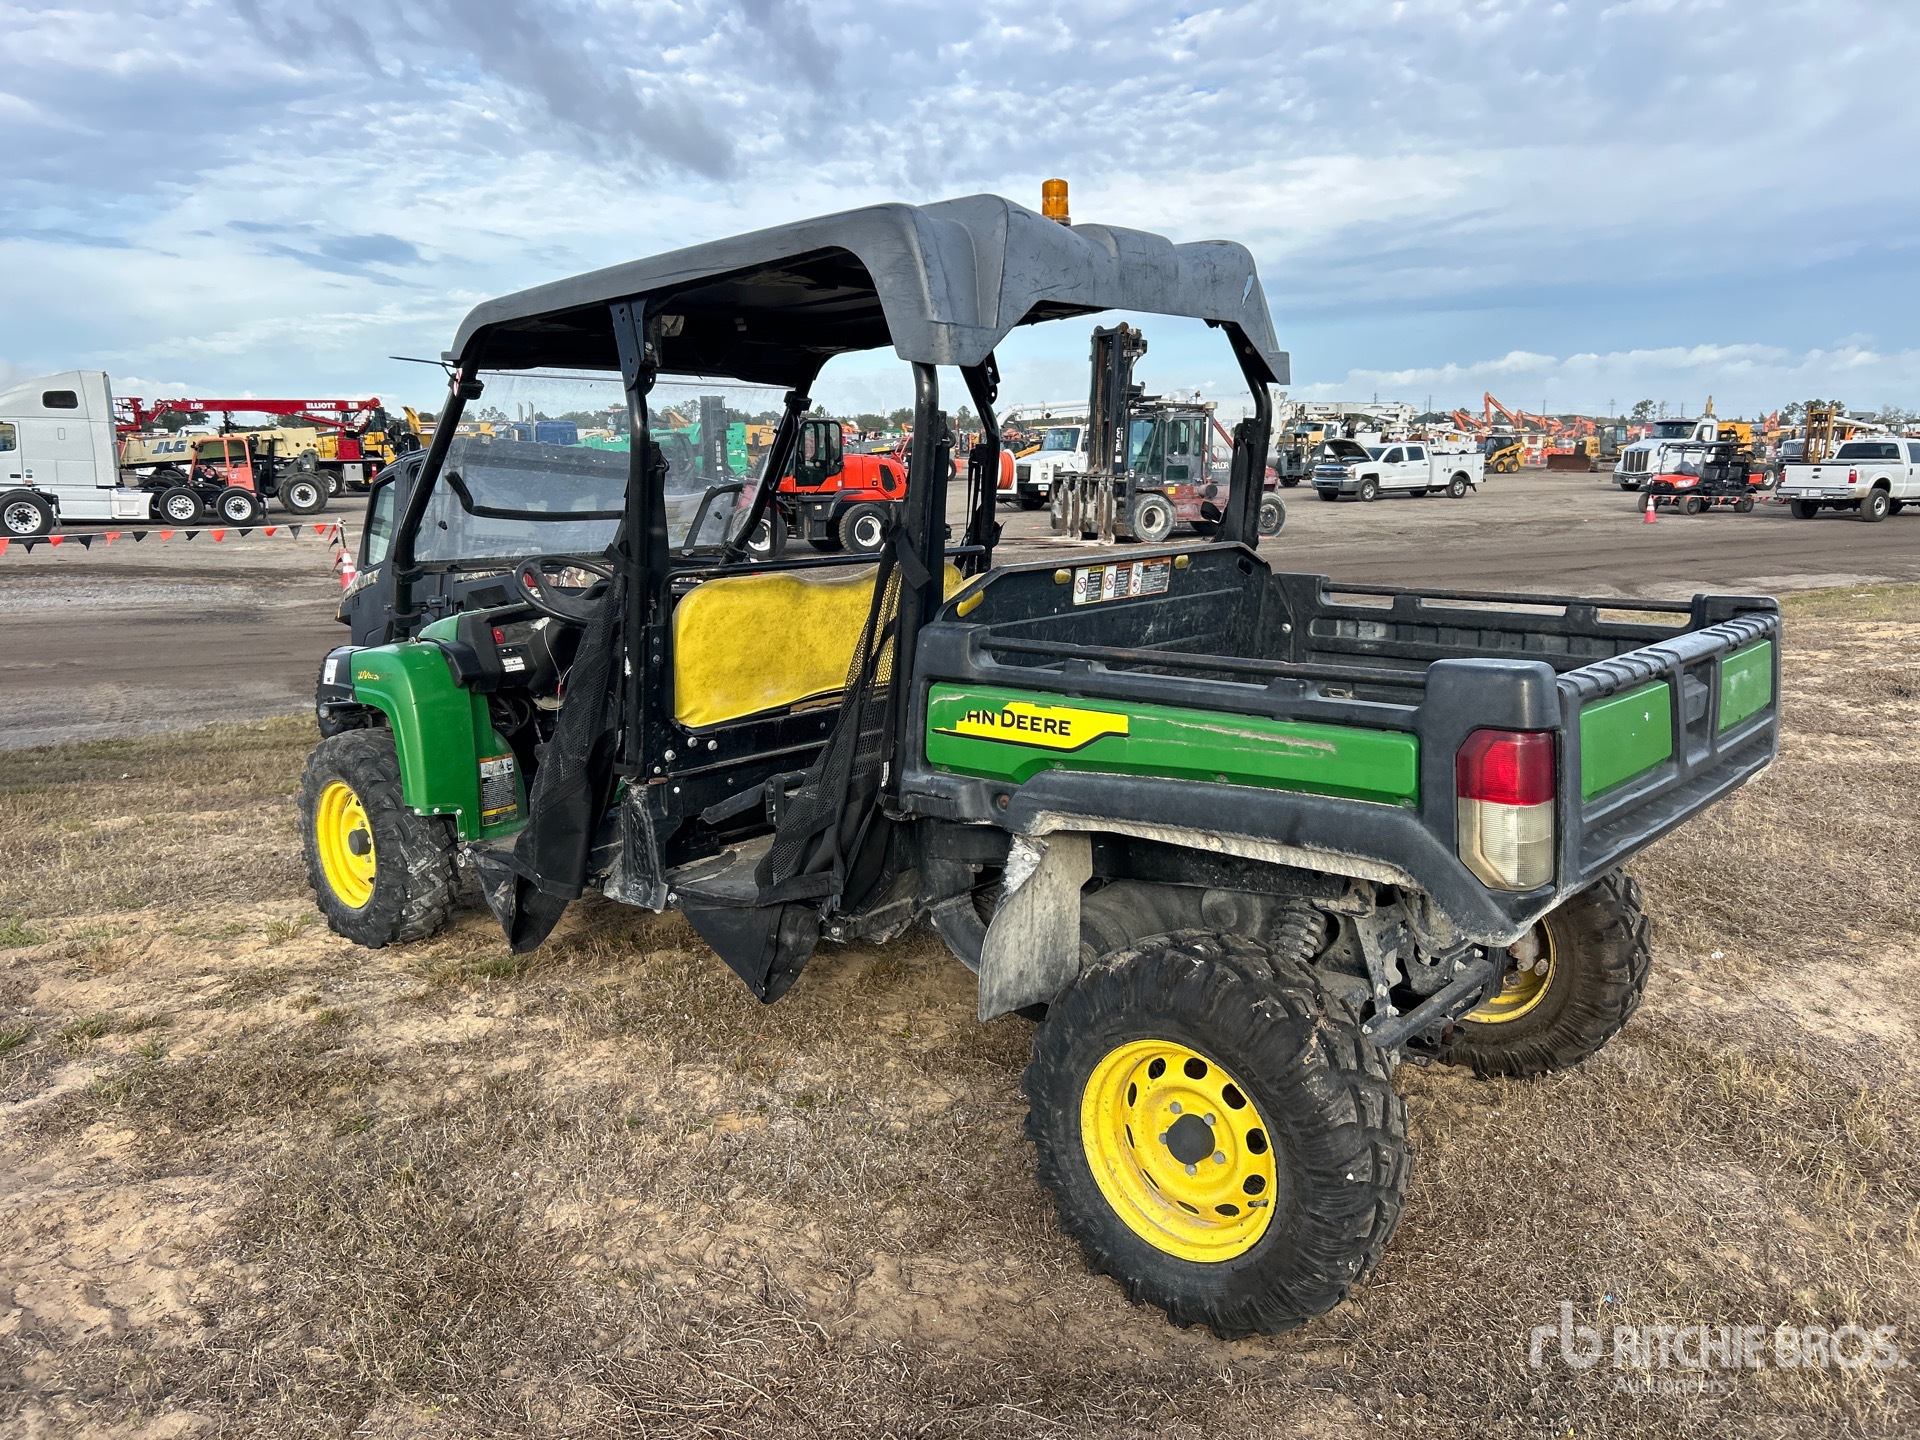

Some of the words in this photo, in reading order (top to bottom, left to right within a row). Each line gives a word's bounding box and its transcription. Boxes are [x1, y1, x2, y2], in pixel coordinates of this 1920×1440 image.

[602, 435, 622, 443] JCB
[152, 440, 187, 455] JLG
[1001, 709, 1072, 737] DEERE
